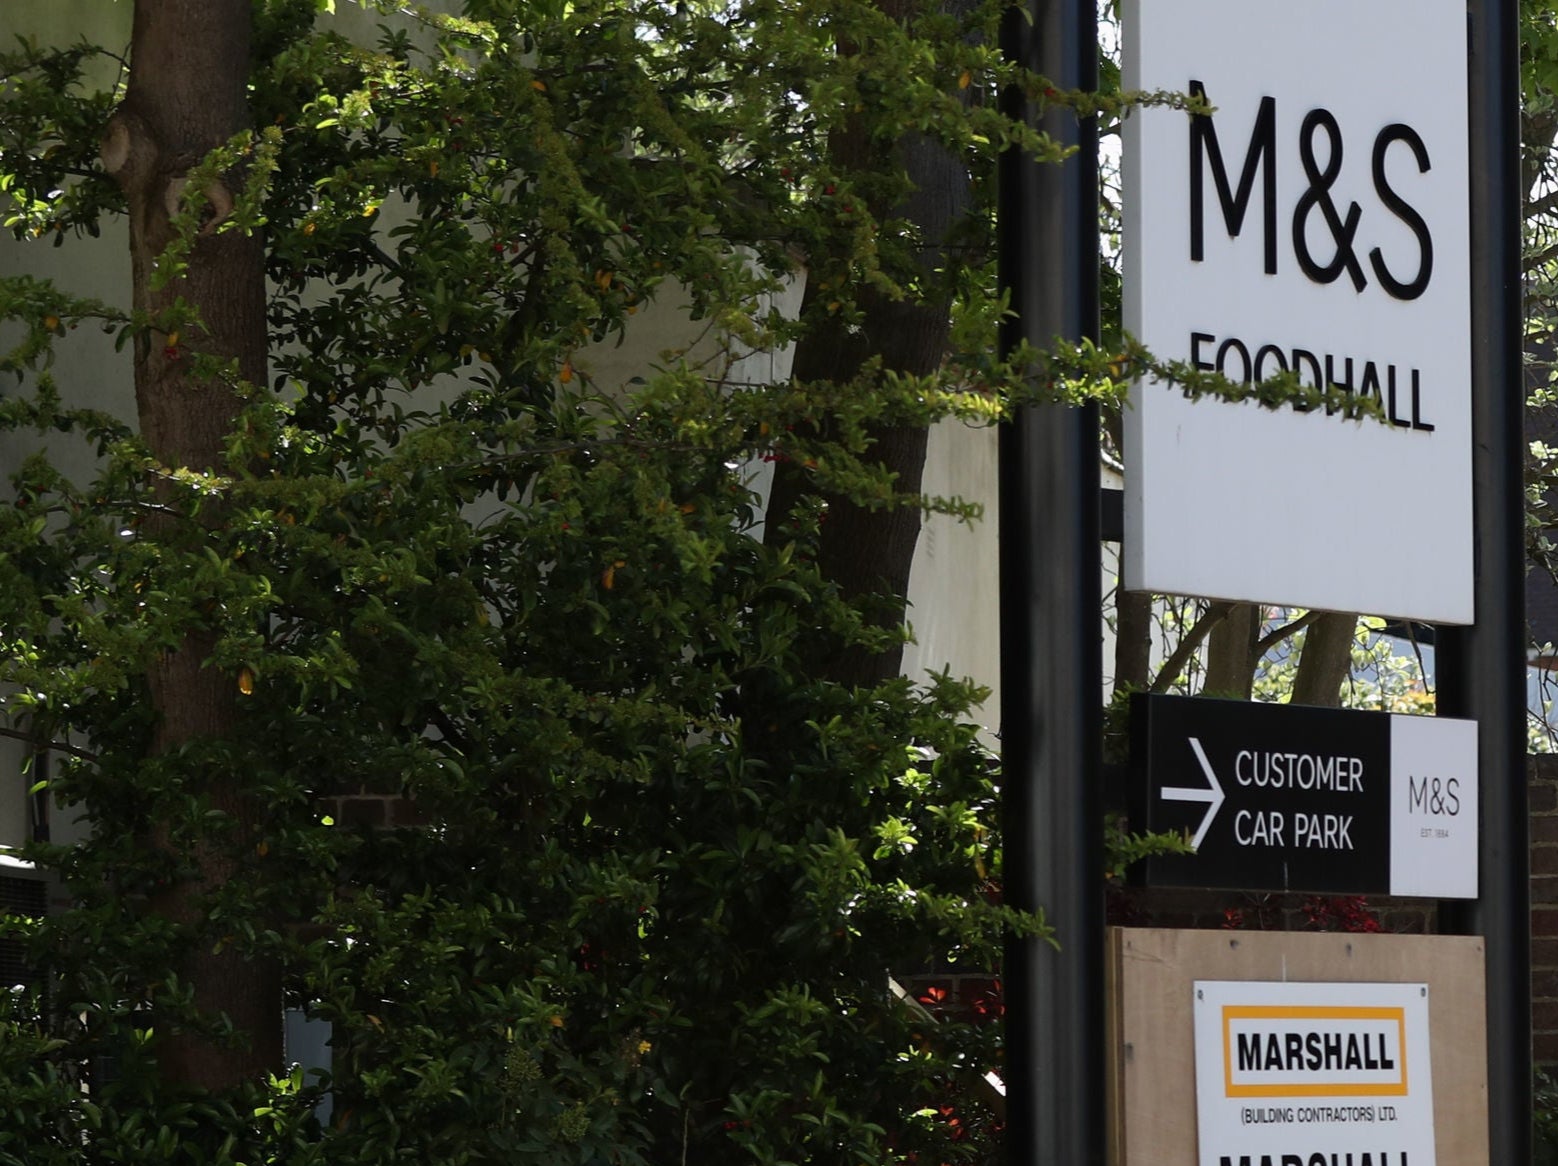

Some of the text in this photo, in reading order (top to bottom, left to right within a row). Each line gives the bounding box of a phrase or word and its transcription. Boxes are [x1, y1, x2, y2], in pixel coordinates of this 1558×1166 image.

[1188, 80, 1434, 301] M&S
[1189, 332, 1435, 432] FOODHALL
[1235, 750, 1364, 792] CUSTOMER
[1409, 774, 1460, 816] M&S
[1234, 809, 1354, 850] CAR PARK
[1237, 1032, 1395, 1072] MARSHALL
[1241, 1105, 1398, 1125] (BUILDING CONTRACTORS) LTD.
